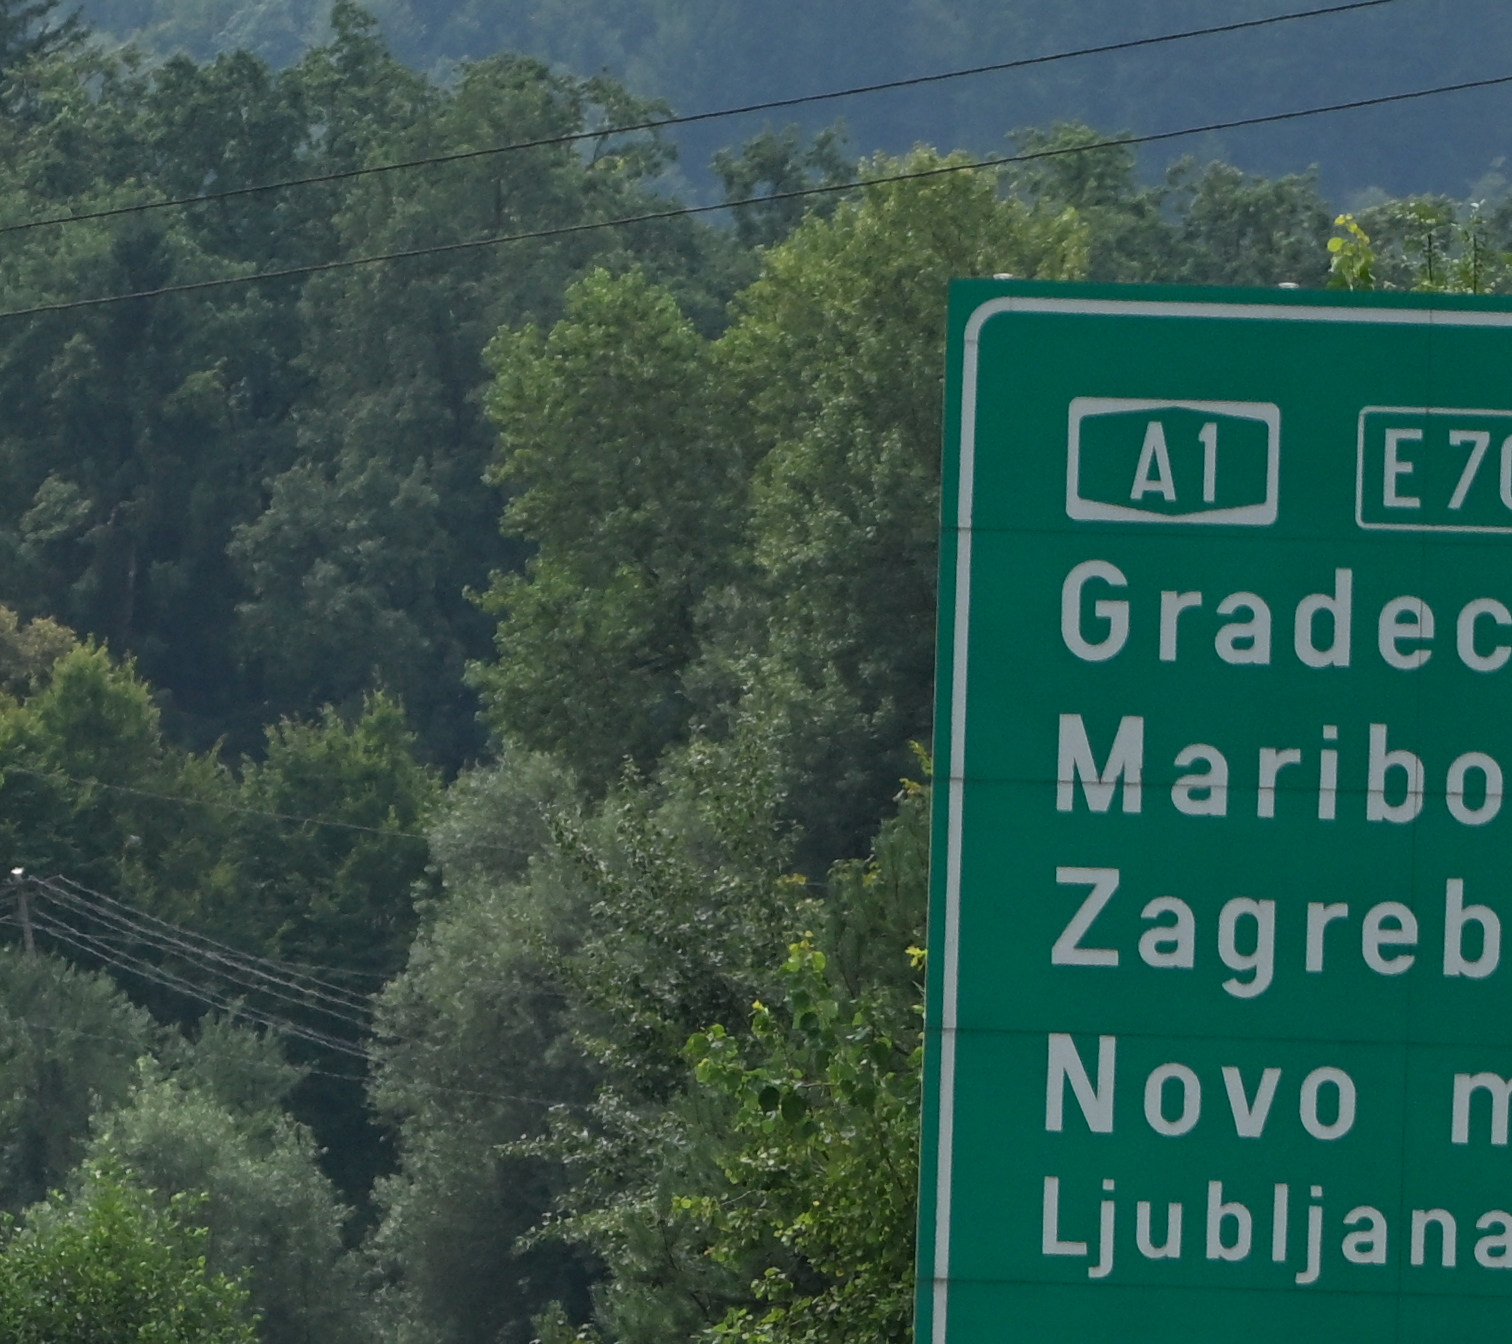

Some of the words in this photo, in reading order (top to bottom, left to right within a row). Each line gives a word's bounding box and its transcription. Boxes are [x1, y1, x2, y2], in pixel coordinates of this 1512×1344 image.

[1128, 421, 1220, 504] A1
[1384, 428, 1422, 510] E
[1051, 866, 1505, 999] Zagreb
[1044, 1032, 1361, 1140] Novo
